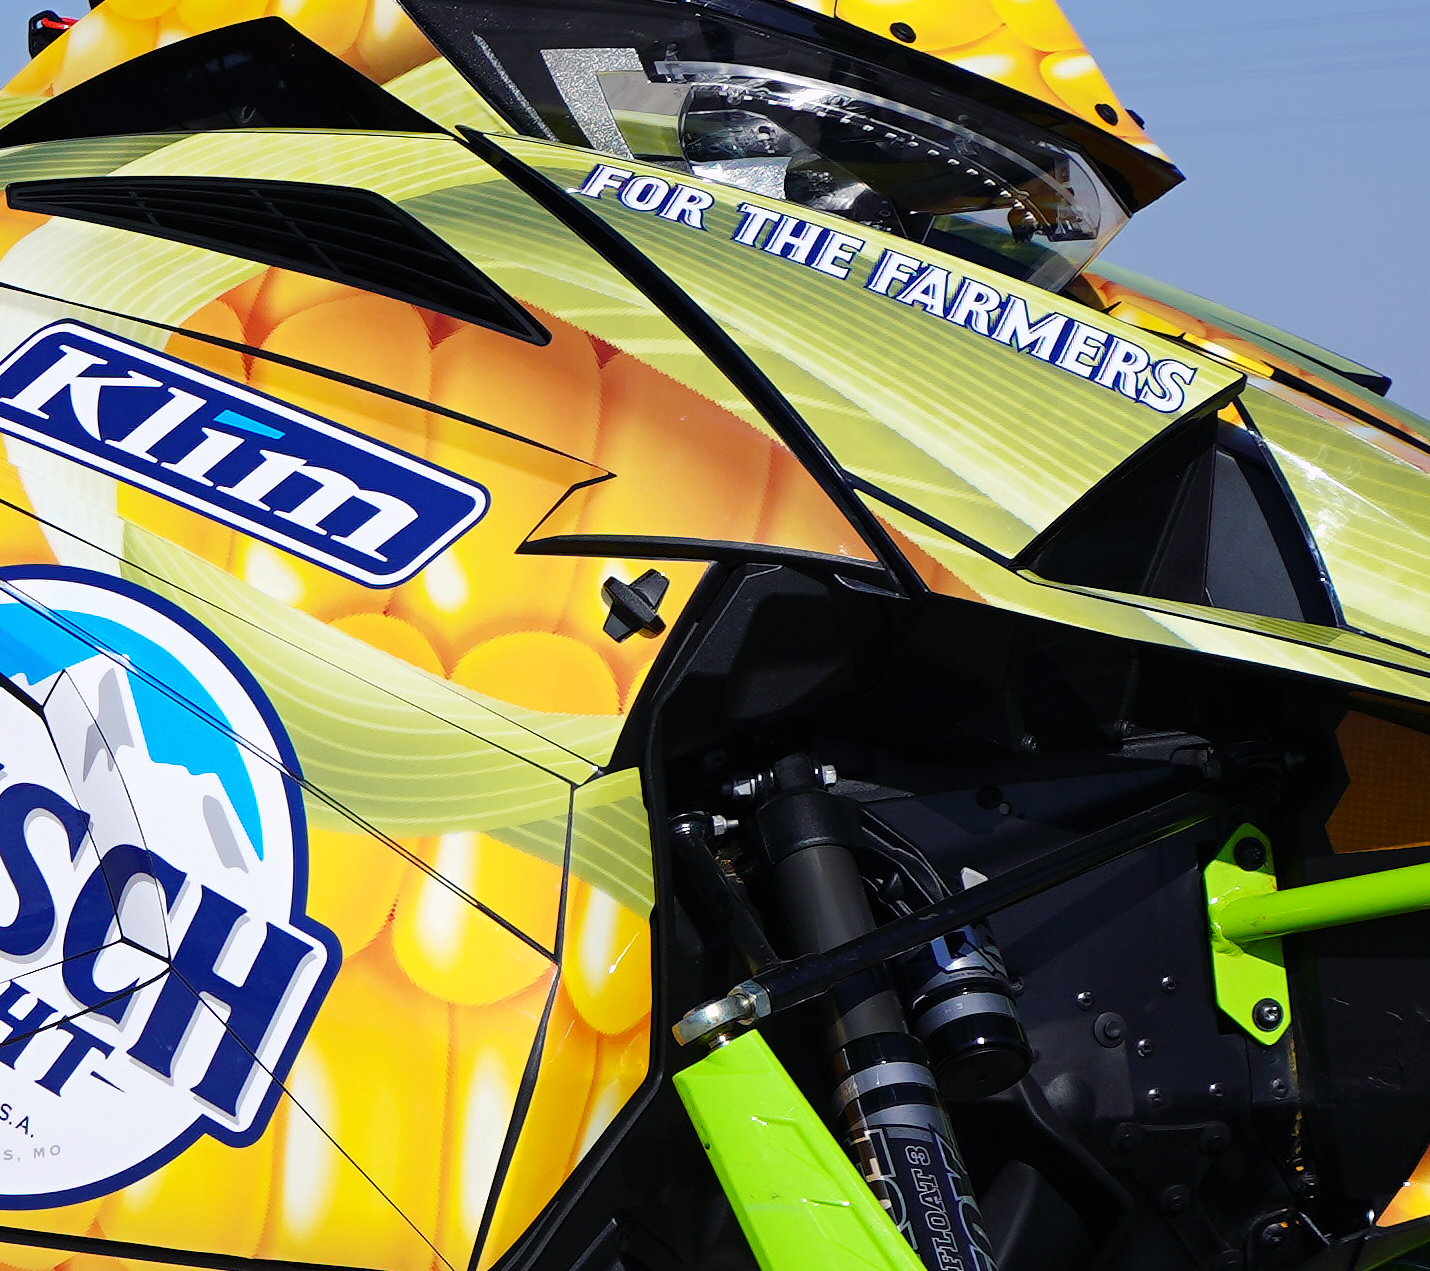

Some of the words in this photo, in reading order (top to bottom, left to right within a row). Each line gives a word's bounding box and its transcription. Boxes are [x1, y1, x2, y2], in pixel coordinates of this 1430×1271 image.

[578, 163, 709, 232] FOR
[731, 201, 866, 280] THE
[865, 248, 1198, 414] FARMERS
[33, 1145, 61, 1160] MO
[904, 1145, 931, 1166] 3
[911, 1168, 965, 1271] FLOAT
